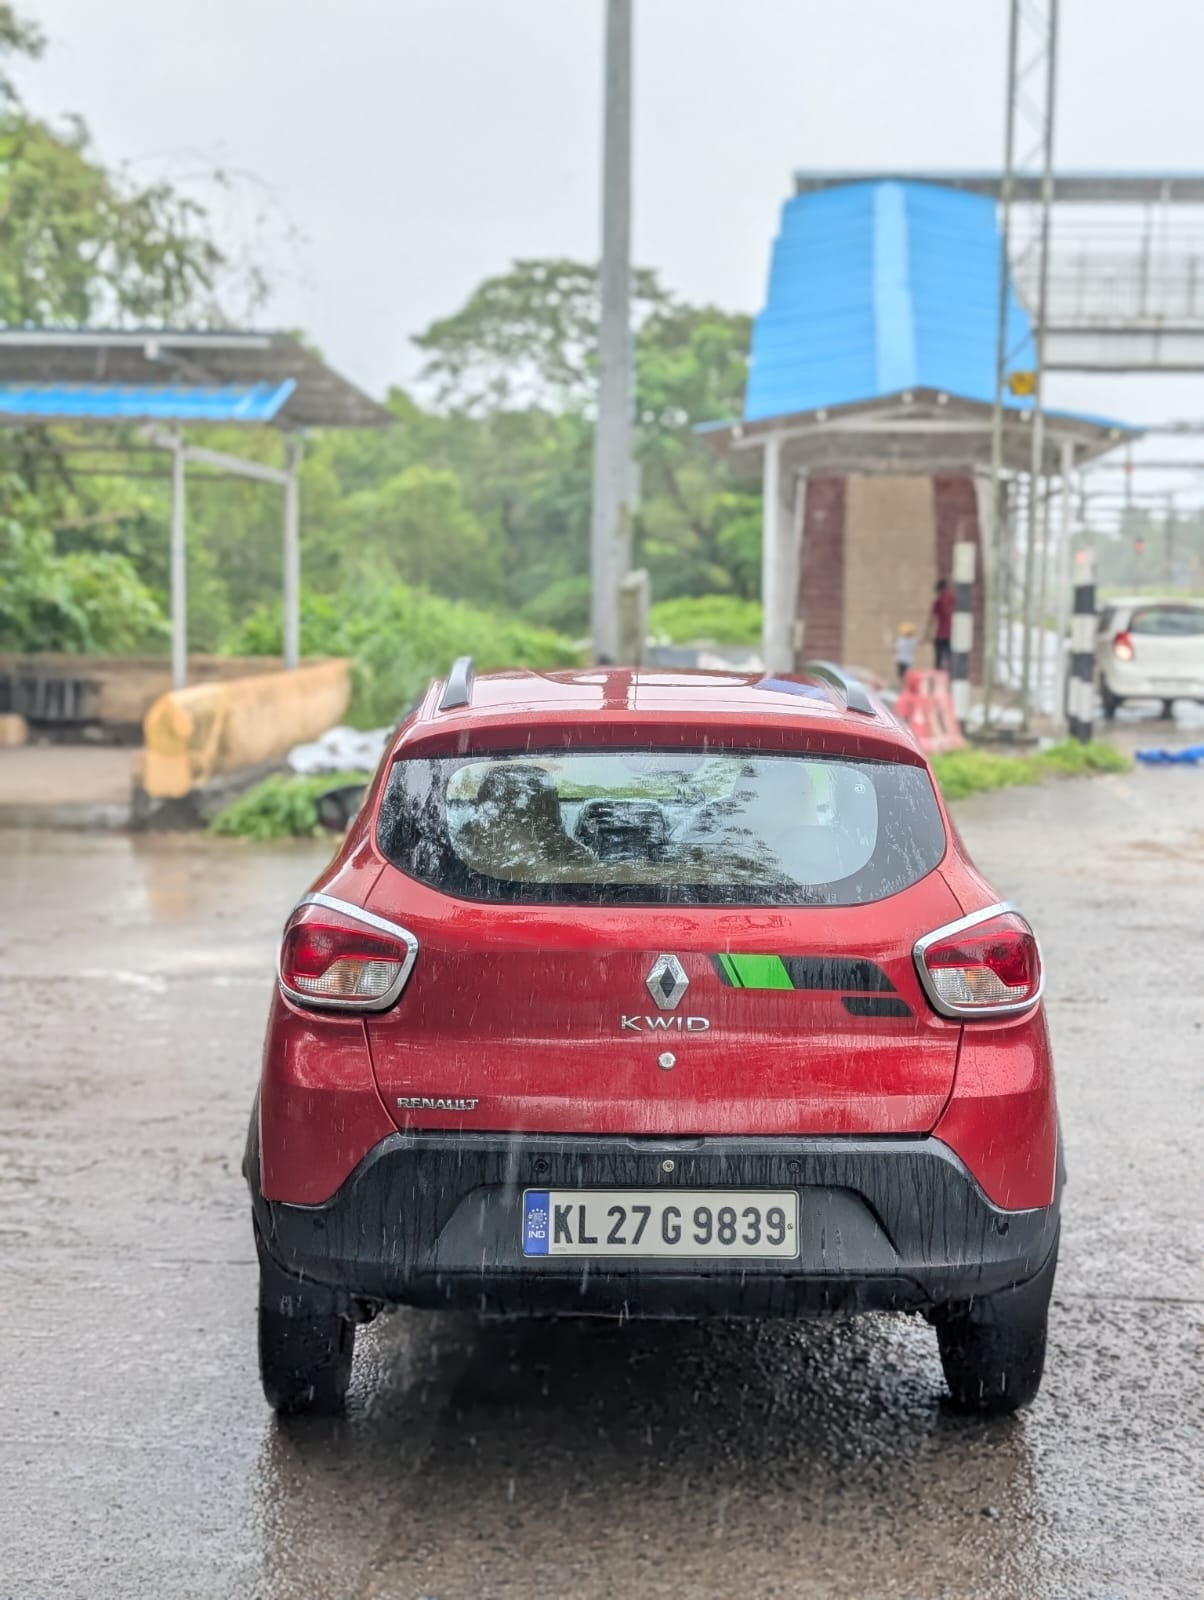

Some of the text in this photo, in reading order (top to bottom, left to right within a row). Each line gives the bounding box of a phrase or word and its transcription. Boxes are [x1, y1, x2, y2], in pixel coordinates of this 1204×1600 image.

[621, 1015, 710, 1032] KWID
[396, 1097, 479, 1111] RENAULT
[553, 1204, 787, 1246] KL 27 G 9839
[528, 1230, 546, 1239] IND
